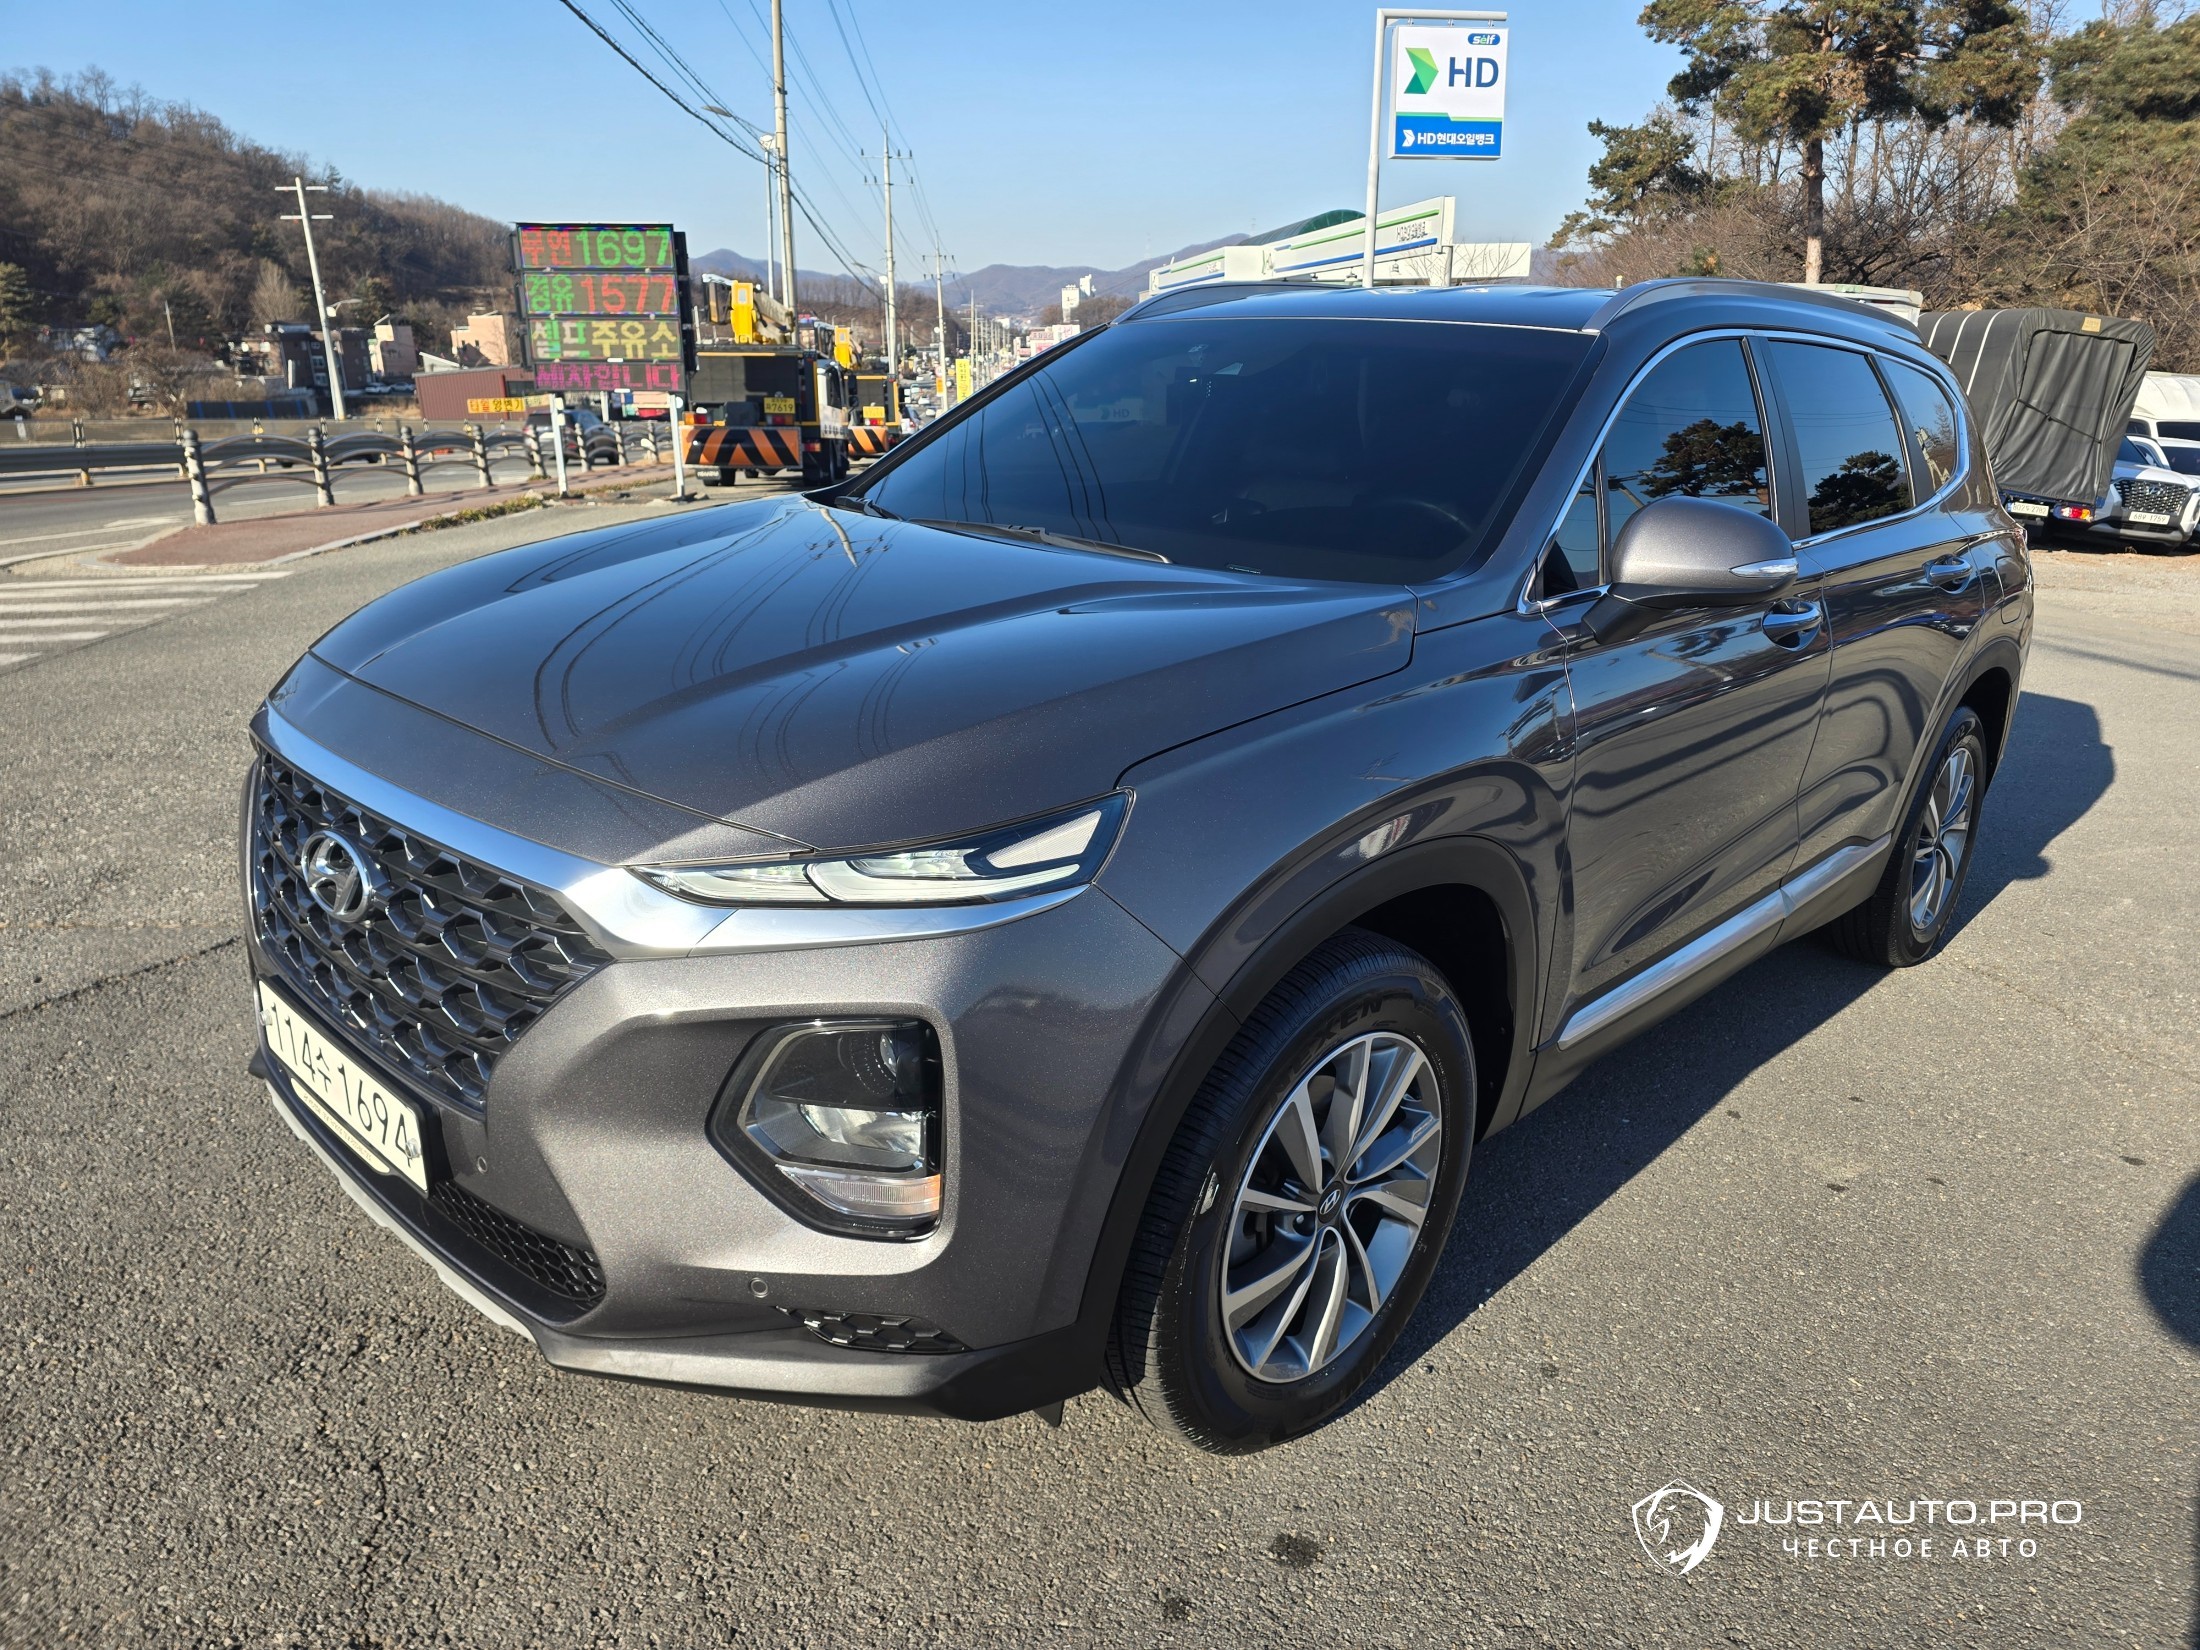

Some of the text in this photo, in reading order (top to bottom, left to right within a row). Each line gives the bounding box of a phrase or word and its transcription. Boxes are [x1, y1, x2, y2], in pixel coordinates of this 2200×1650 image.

[1448, 57, 1499, 88] HD
[1417, 132, 1495, 146] HD현대오일뱅크
[521, 230, 670, 266] 무연 1697
[527, 275, 675, 312] 경유 1577
